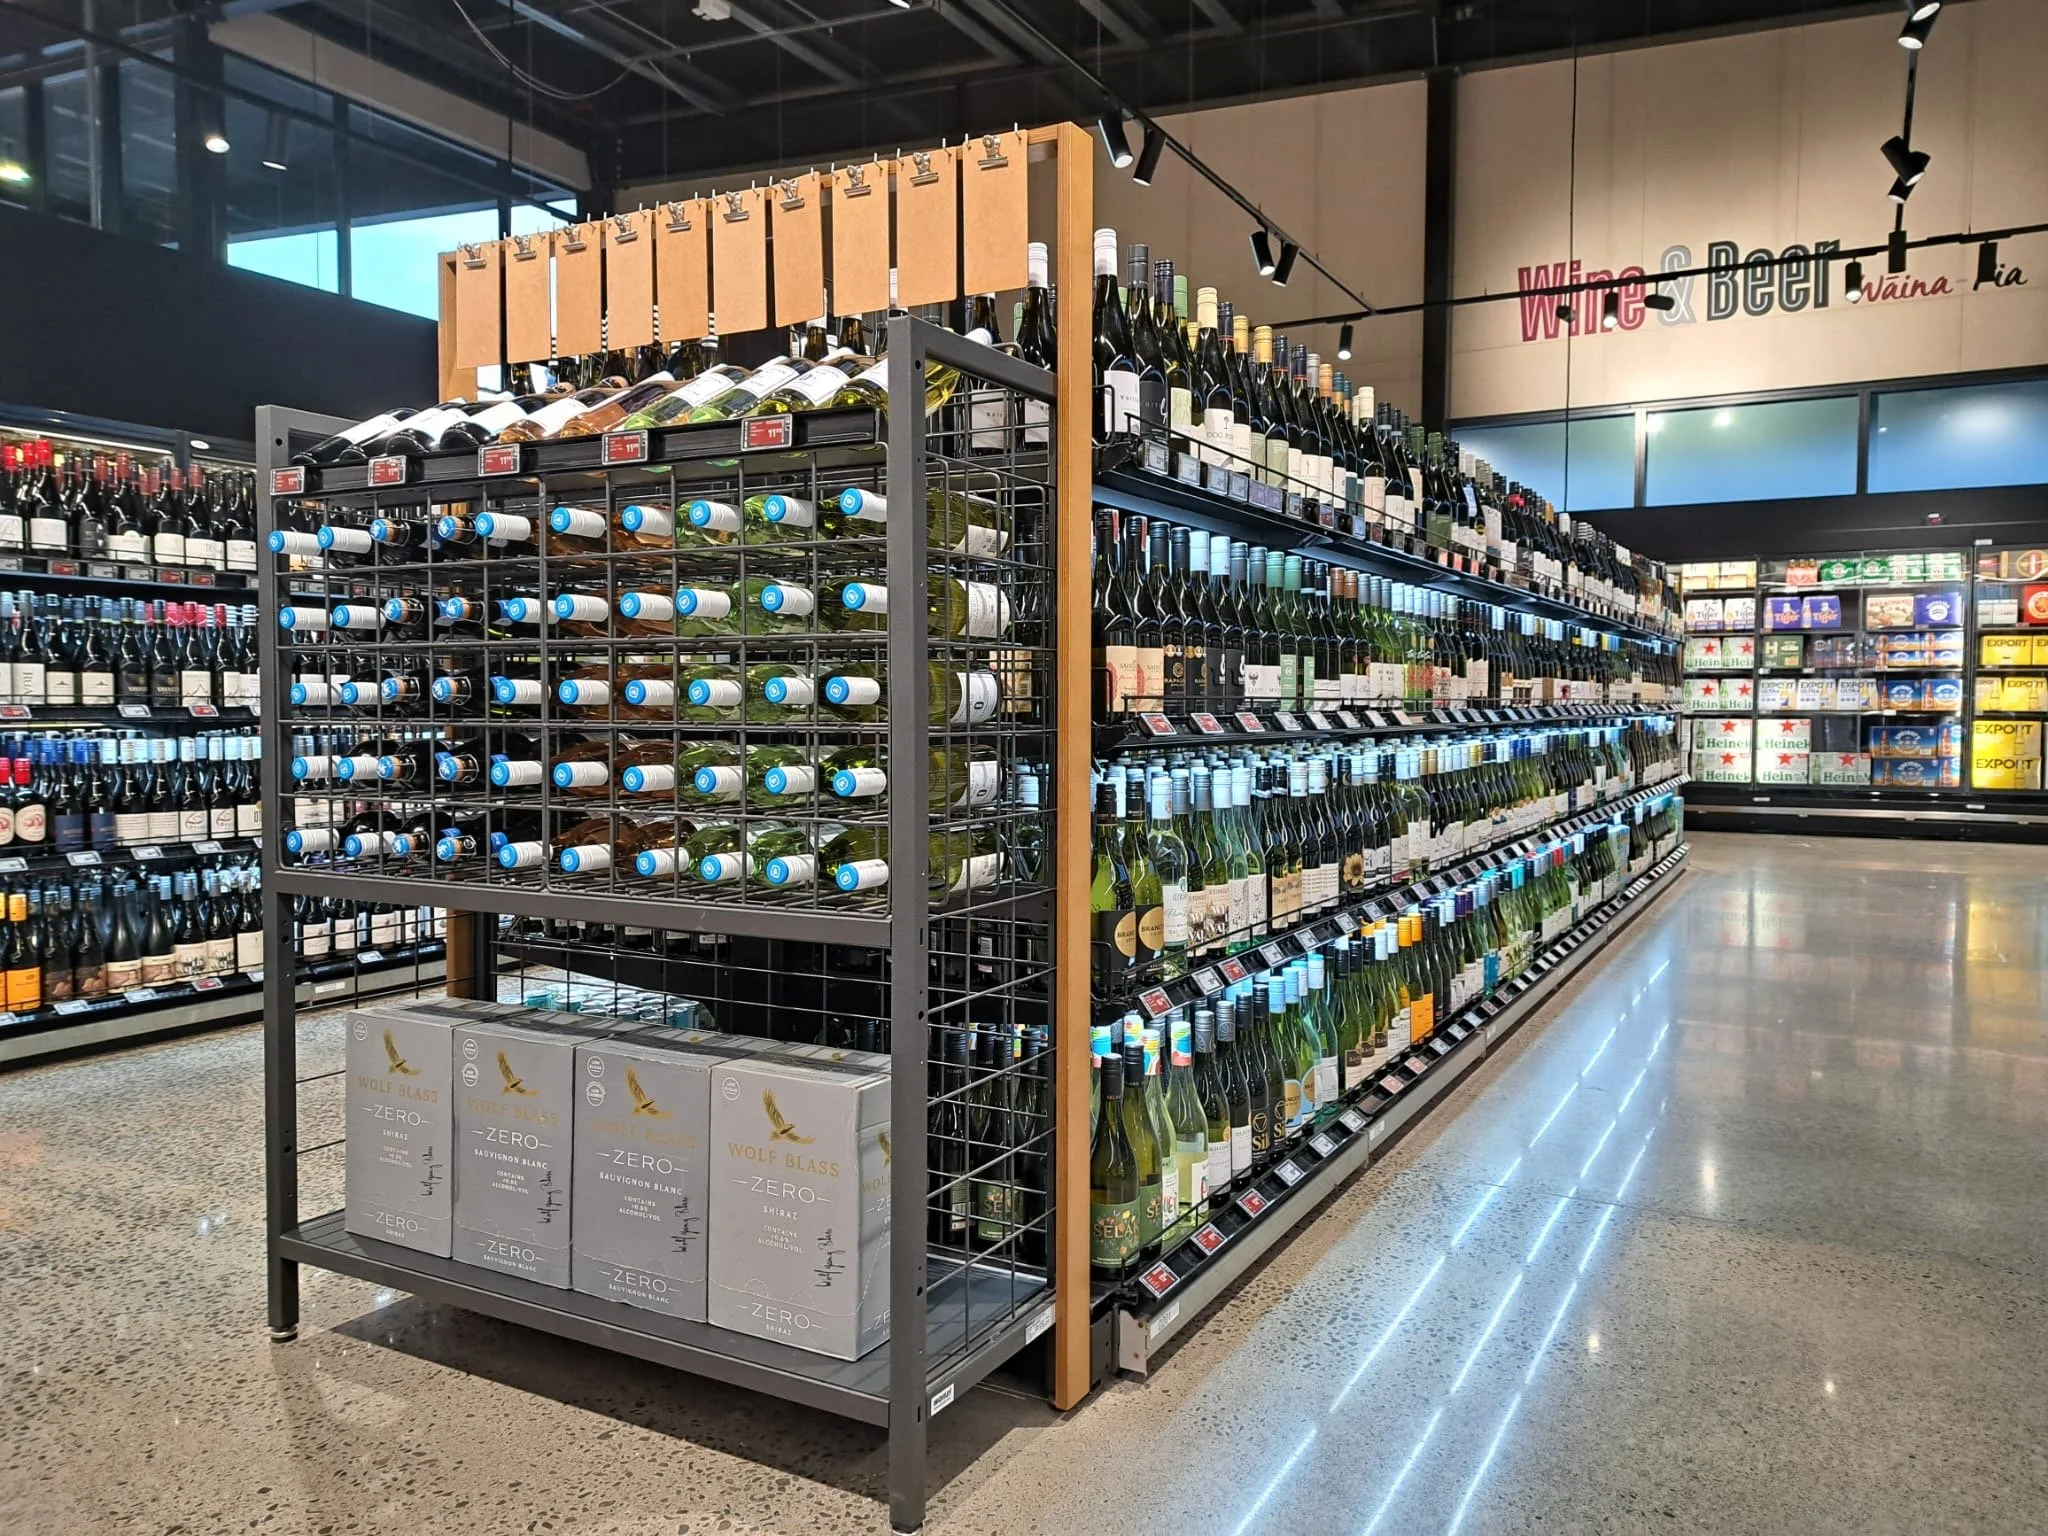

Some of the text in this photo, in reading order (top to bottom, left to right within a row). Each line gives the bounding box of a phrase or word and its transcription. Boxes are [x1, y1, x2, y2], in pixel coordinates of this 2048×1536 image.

[1517, 239, 1840, 343] Wine & Beer
[1774, 613, 1800, 625] Tiger
[1812, 612, 1838, 625] Tiger
[1987, 639, 2028, 647] EXPORT
[357, 1076, 439, 1103] WOLF BLASS
[374, 1104, 421, 1126] ZERO
[468, 1097, 560, 1127] WOLF BLASS
[383, 1128, 409, 1141] SHIRAZ
[486, 1127, 539, 1150] ZERO
[474, 1148, 548, 1170] SAUVIGNON BLANC
[613, 1149, 673, 1174] ZERO
[728, 1142, 840, 1177] WOLF BLASS
[599, 1171, 683, 1196] SAUVIGNON BLANC
[751, 1176, 815, 1204] ZERO
[624, 1195, 656, 1207] CONTAINS
[376, 1211, 418, 1232] ZERO
[763, 1205, 800, 1221] SHIRAZ
[386, 1228, 405, 1239] SHIRAZ
[763, 1224, 798, 1238] CONTAINS
[487, 1240, 535, 1262] ZERO
[757, 1238, 803, 1254] ALCOHOL/VOL
[483, 1254, 537, 1273] SAUVIGNON BLANC
[613, 1268, 667, 1293] ZERO
[609, 1283, 670, 1304] SAUVIGNON BLANC
[751, 1302, 810, 1329] ZERO
[765, 1323, 792, 1336] SHIRAZ
